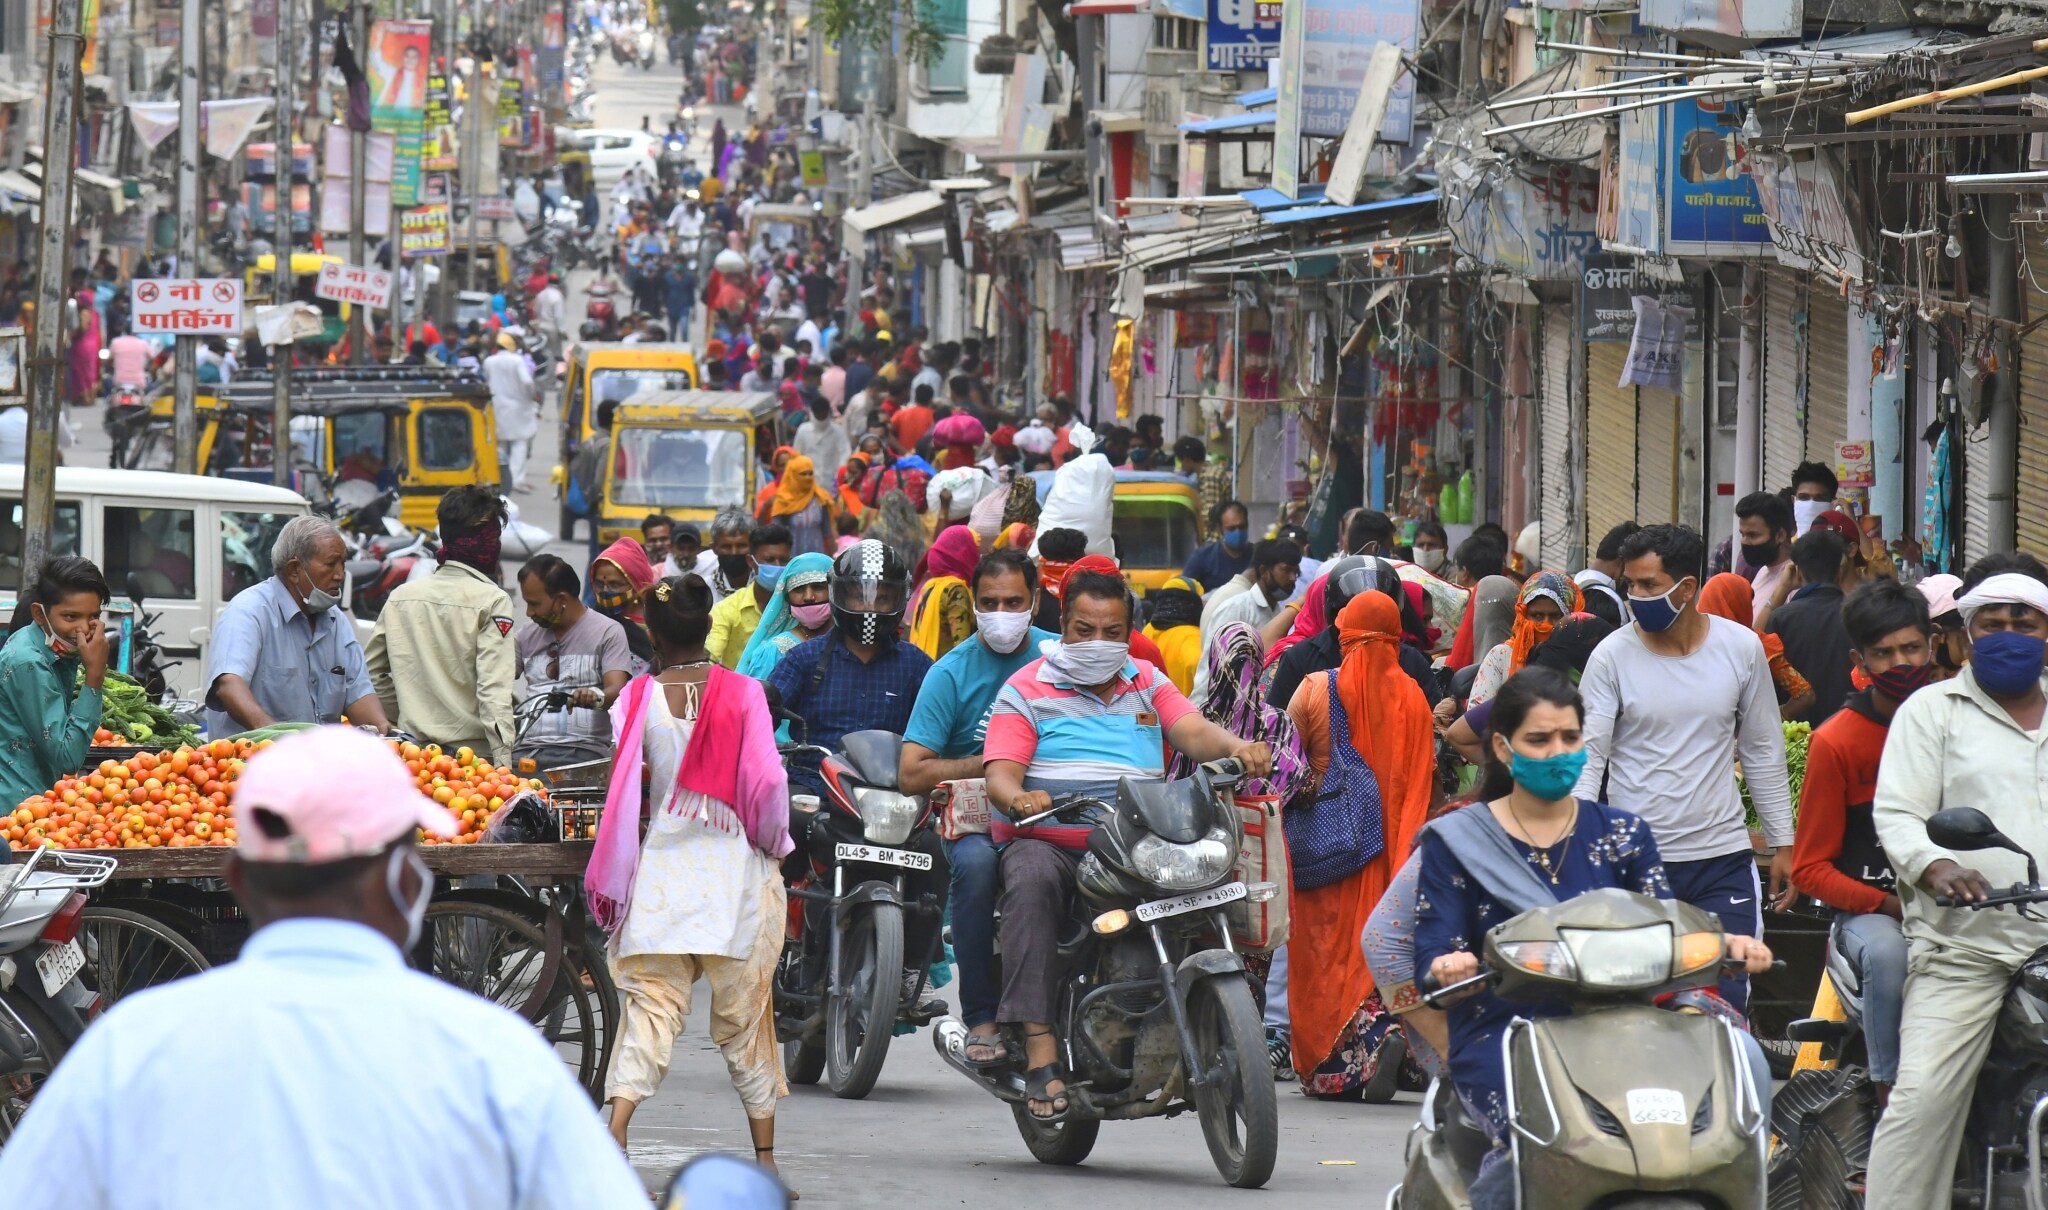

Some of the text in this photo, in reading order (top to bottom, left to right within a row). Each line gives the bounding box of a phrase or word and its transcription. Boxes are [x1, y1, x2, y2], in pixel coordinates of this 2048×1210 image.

[1685, 192, 1713, 206] पाली
[168, 281, 204, 301] नो
[138, 308, 235, 329] पार्किंग
[957, 812, 992, 825] WIRES
[878, 850, 894, 862] BM
[1214, 885, 1243, 902] 4930
